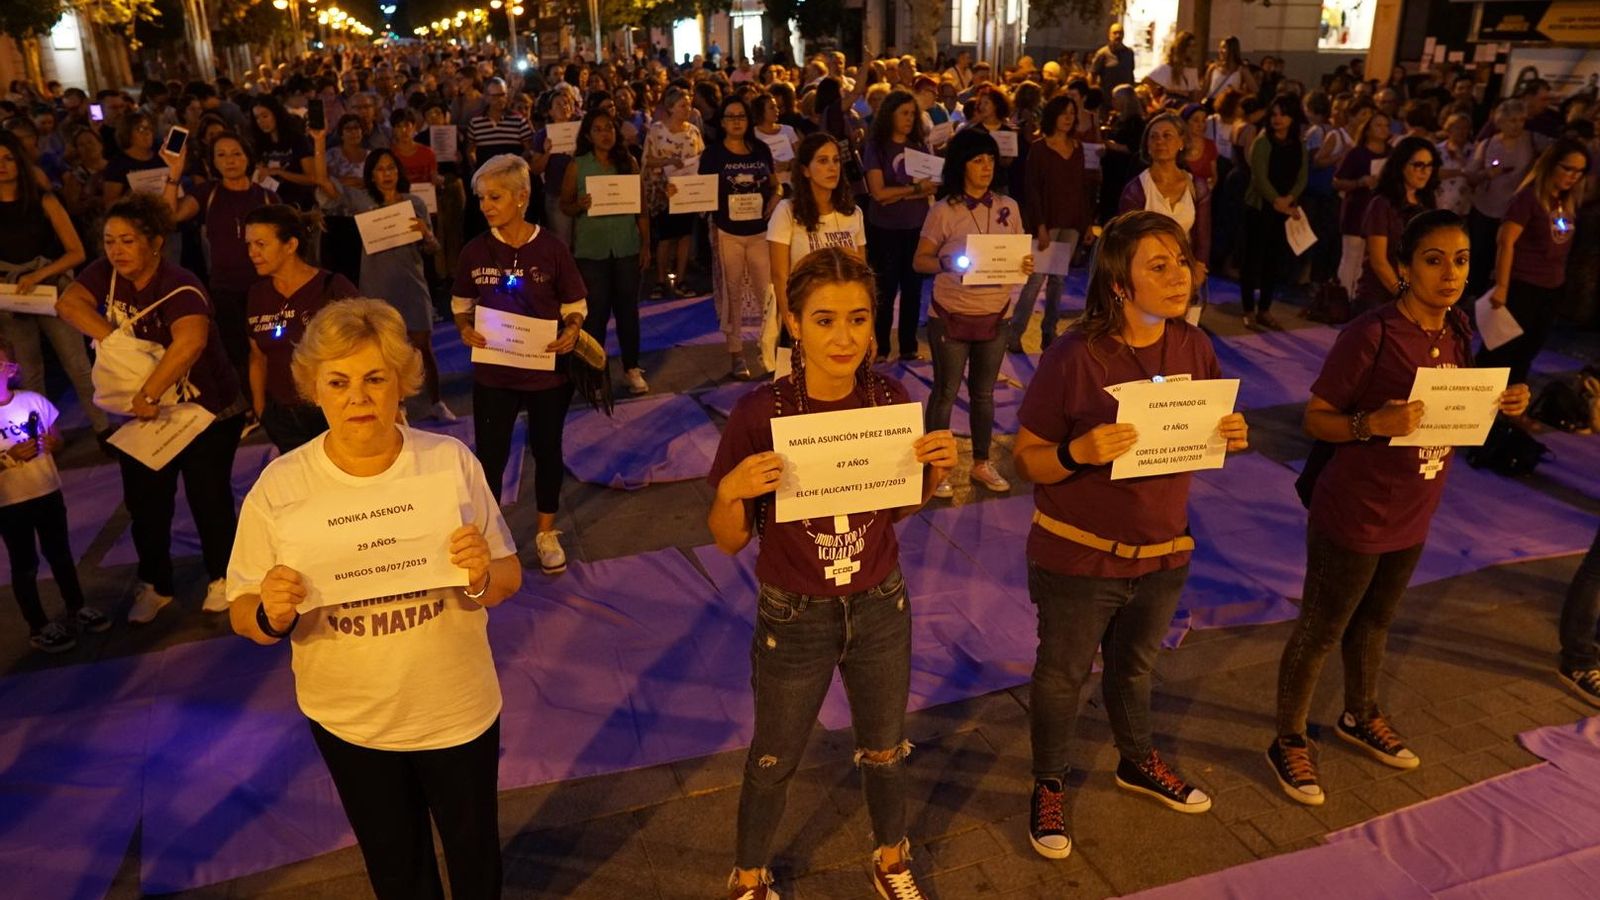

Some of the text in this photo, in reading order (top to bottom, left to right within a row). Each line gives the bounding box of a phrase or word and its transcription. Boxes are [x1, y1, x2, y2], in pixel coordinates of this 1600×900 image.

[1431, 384, 1448, 392] MARÍA
[1148, 401, 1168, 409] ELENA
[1168, 400, 1197, 408] PEINADO
[1171, 422, 1189, 431] AÑOS
[788, 426, 913, 447] MARÍA ASUNCIÓN PÉREZ IBARRA
[1135, 448, 1159, 456] CORTES
[1176, 443, 1208, 453] FRONTERA
[836, 457, 869, 469] 47 AÑOS
[1137, 454, 1203, 467] (MÁLAGA) 16/07/2019
[796, 477, 906, 498] ELCHE (ALICANTE) 13/07/2019
[327, 503, 415, 528] MONIKA ASENOVA
[357, 537, 397, 552] 29 AÑOS
[814, 532, 844, 548] UNIDAS
[818, 537, 866, 560] IGUALDAD
[334, 557, 428, 581] BURGOS 08/07/2019
[832, 565, 854, 575] CCOO
[327, 598, 445, 637] NOS MATAN
